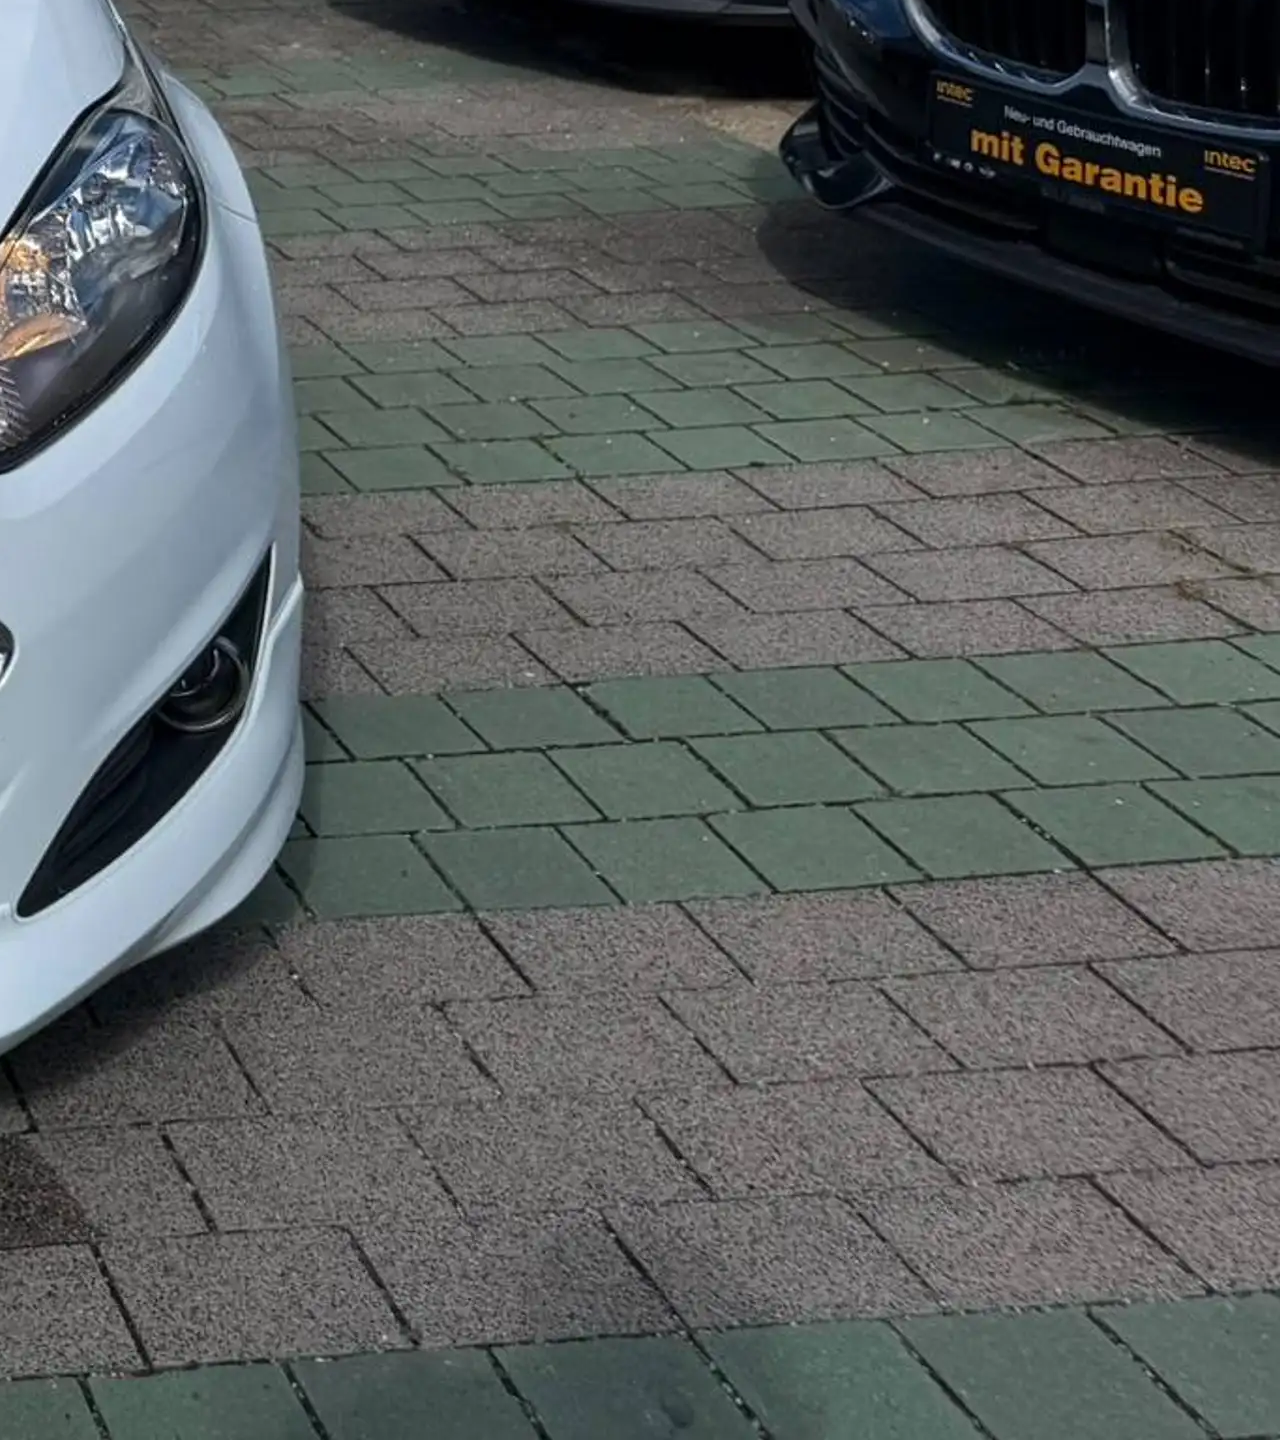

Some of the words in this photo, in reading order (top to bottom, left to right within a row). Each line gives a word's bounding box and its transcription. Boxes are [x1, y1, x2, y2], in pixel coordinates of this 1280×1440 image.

[1033, 117, 1054, 130] und
[1057, 120, 1162, 157] Gebrauchtwagen
[970, 128, 1024, 166] mit
[1035, 142, 1204, 213] Garantie
